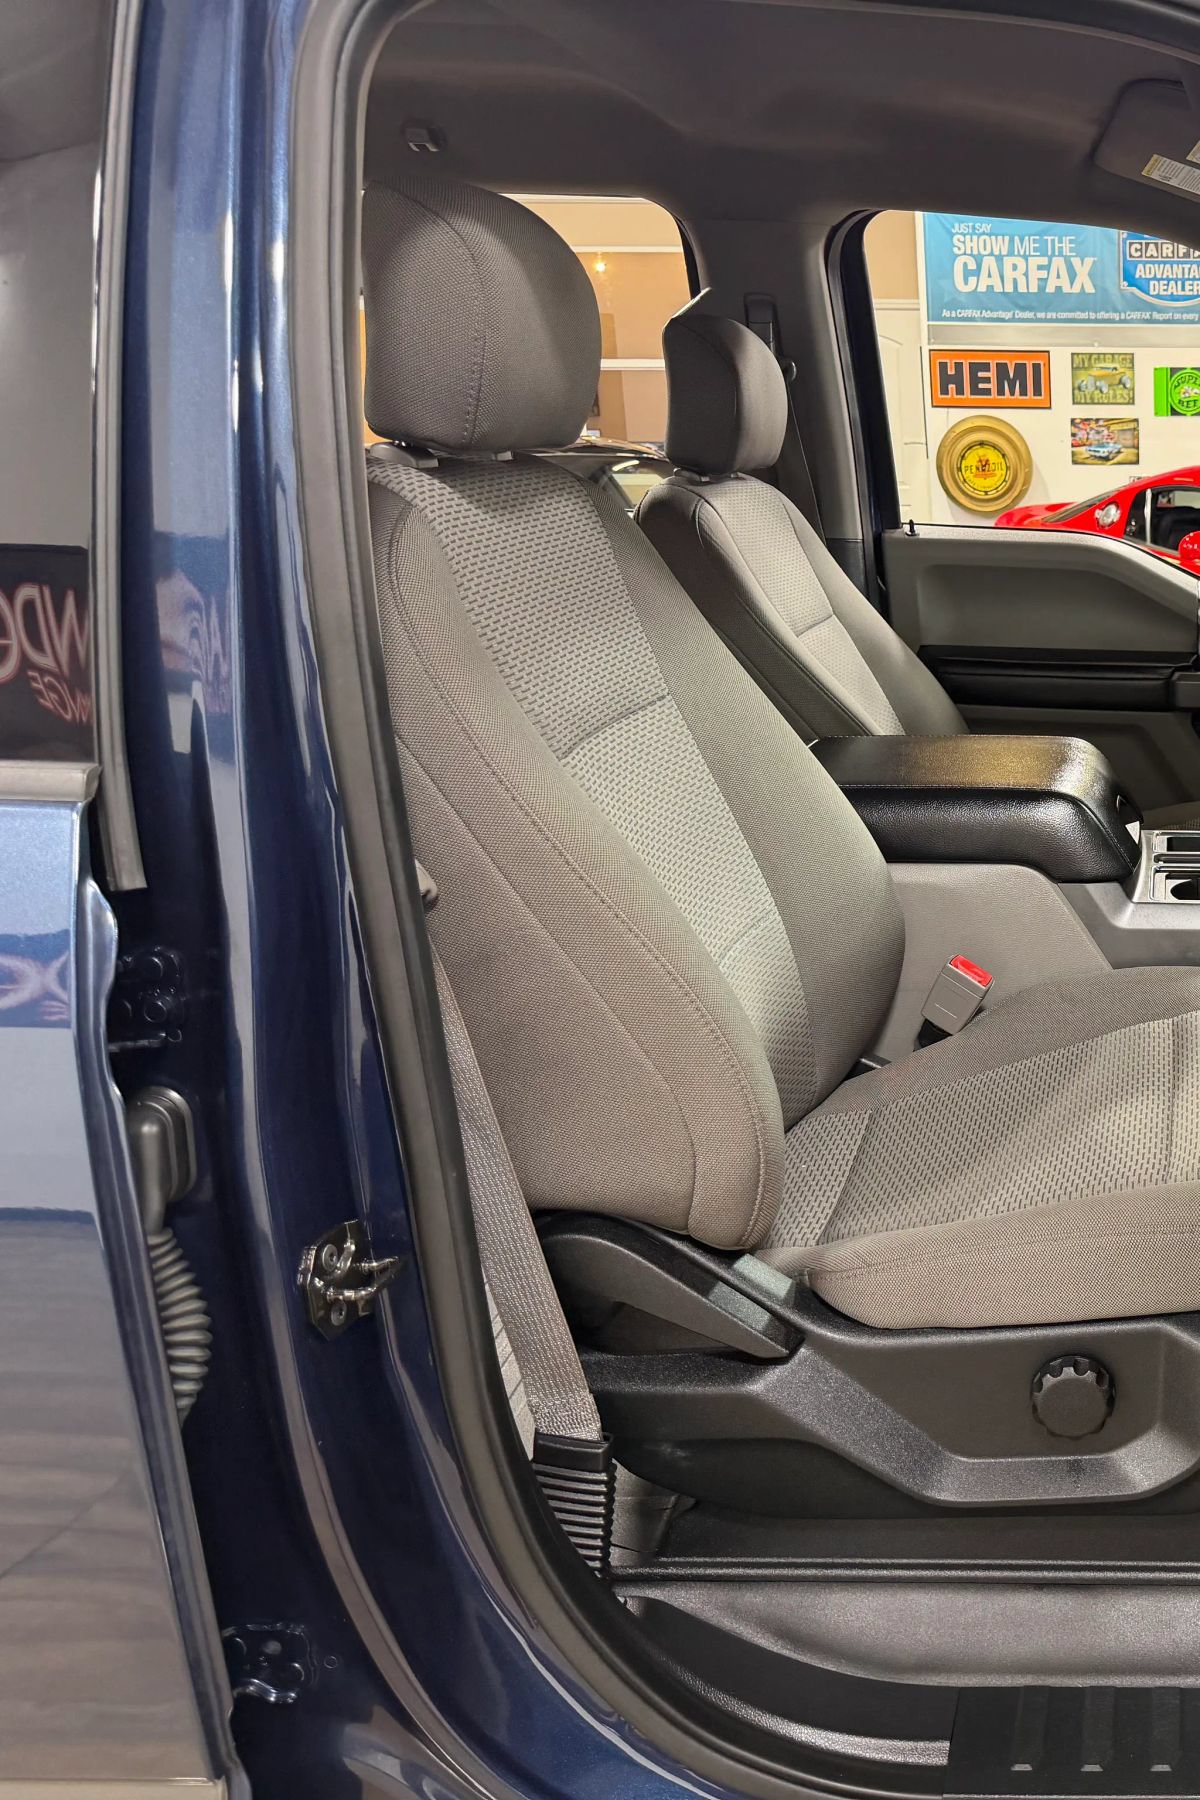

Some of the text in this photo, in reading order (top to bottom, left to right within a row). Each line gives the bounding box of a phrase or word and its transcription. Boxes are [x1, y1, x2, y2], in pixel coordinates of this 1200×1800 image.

[951, 223, 992, 234] JUST SAY
[952, 234, 1076, 256] SHOW ME THE
[953, 255, 1096, 293] CARFAX
[1057, 311, 1088, 319] committed
[1097, 311, 1119, 321] offering
[1152, 312, 1172, 321] Report
[1182, 313, 1199, 321] every
[1073, 354, 1133, 368] MY GARAGE
[937, 360, 1044, 398] HEMI
[1074, 390, 1091, 403] MY
